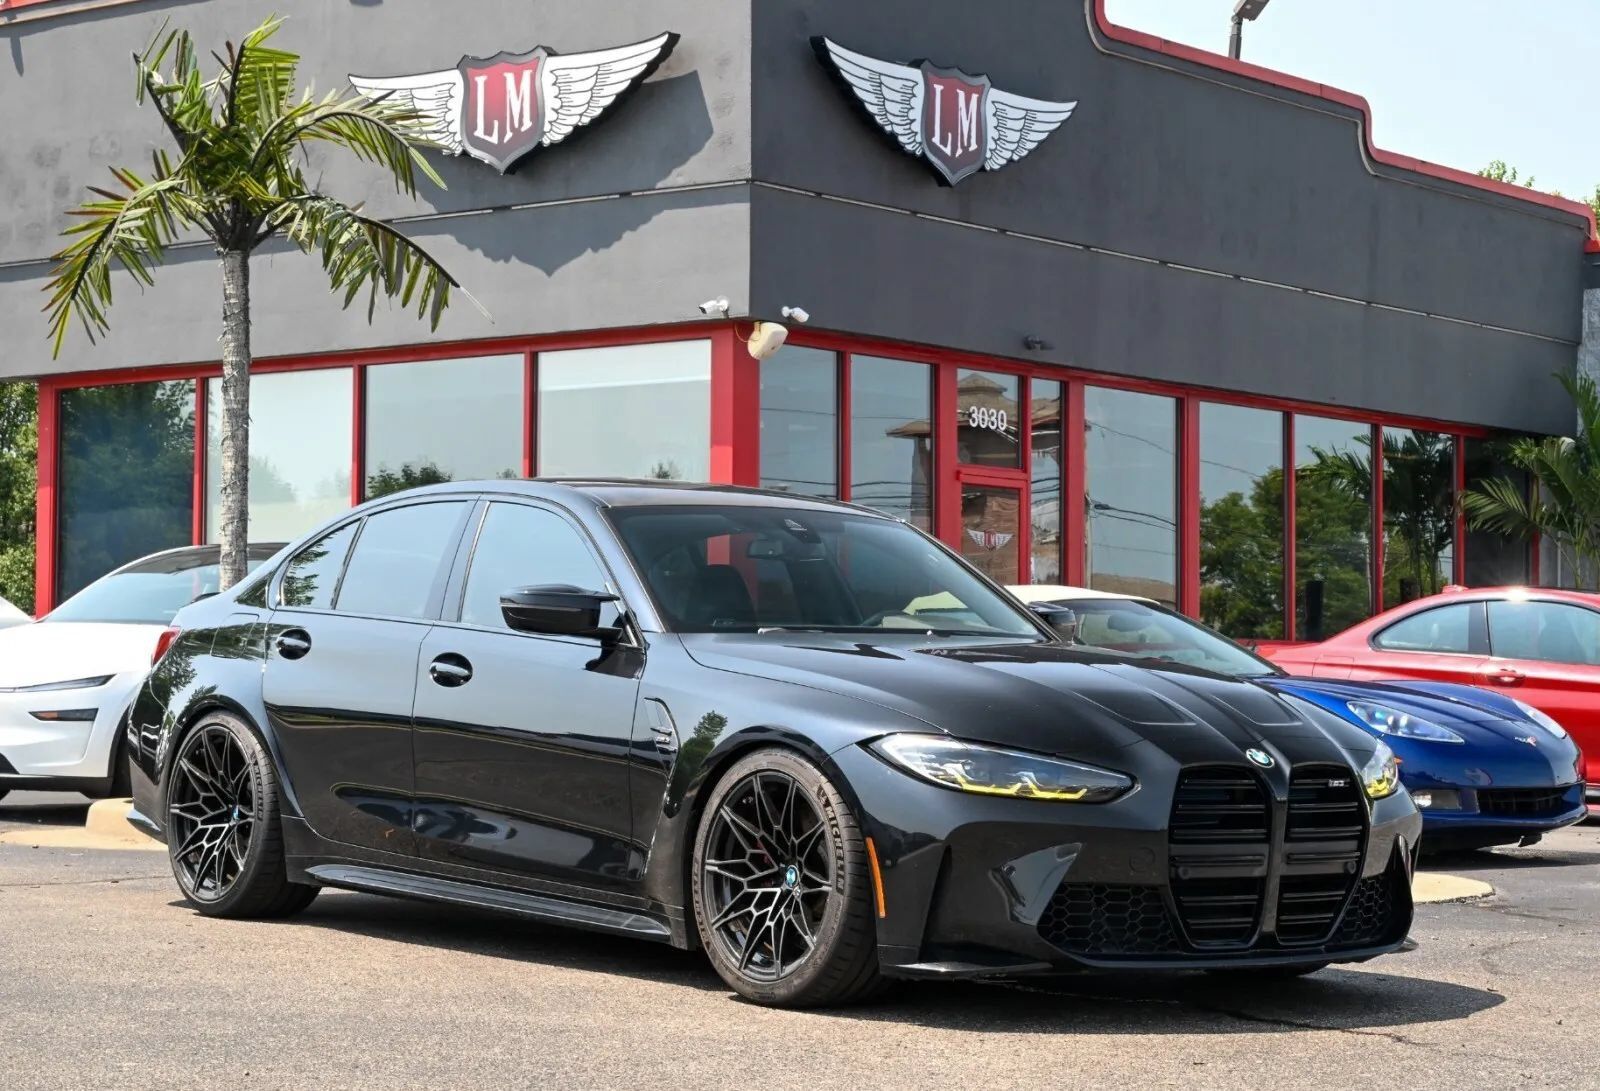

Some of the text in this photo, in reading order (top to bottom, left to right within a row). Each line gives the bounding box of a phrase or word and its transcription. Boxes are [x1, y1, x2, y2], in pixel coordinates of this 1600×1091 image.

[474, 69, 534, 145] LM
[931, 84, 980, 158] LM
[969, 405, 1007, 431] 3030
[825, 804, 845, 892] MICHELIN
